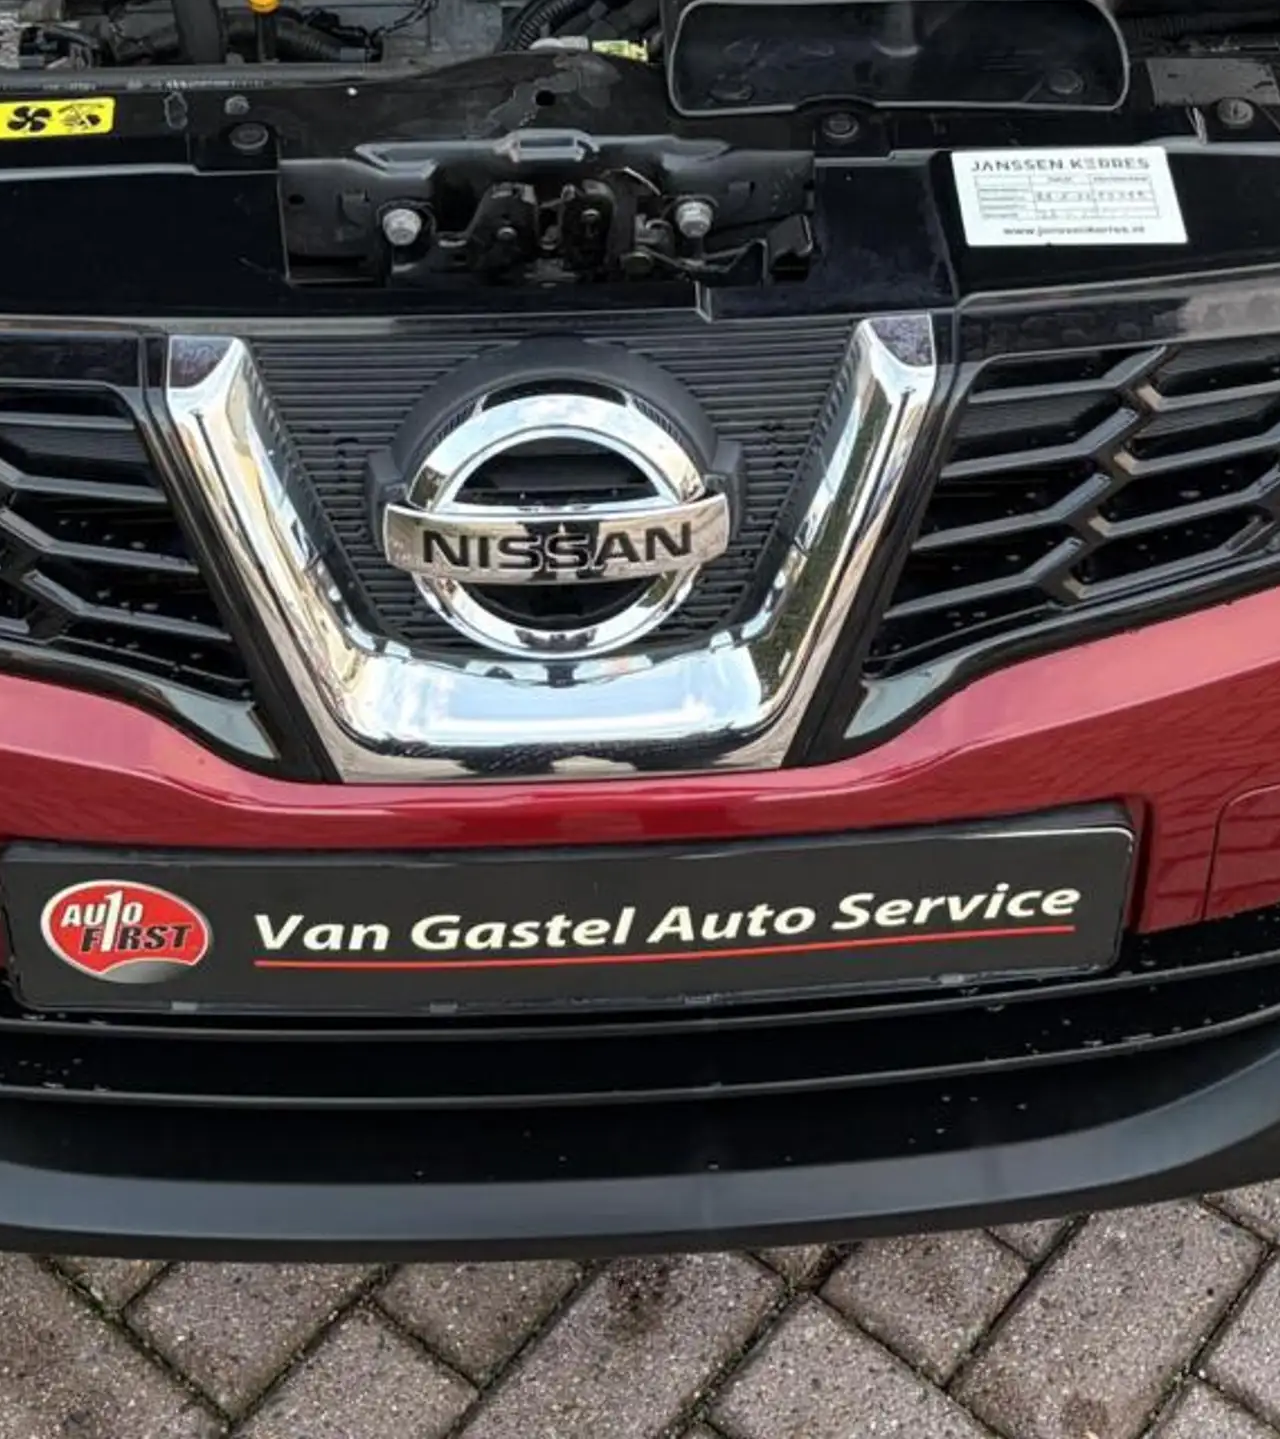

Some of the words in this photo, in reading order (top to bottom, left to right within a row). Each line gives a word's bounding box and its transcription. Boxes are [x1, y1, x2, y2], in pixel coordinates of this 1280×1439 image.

[971, 159, 1064, 173] JANSSEN
[422, 521, 693, 570] NISSAN
[254, 913, 391, 951] Van
[410, 906, 636, 951] Gastel
[646, 902, 817, 944] Auto
[831, 882, 1082, 931] Service
